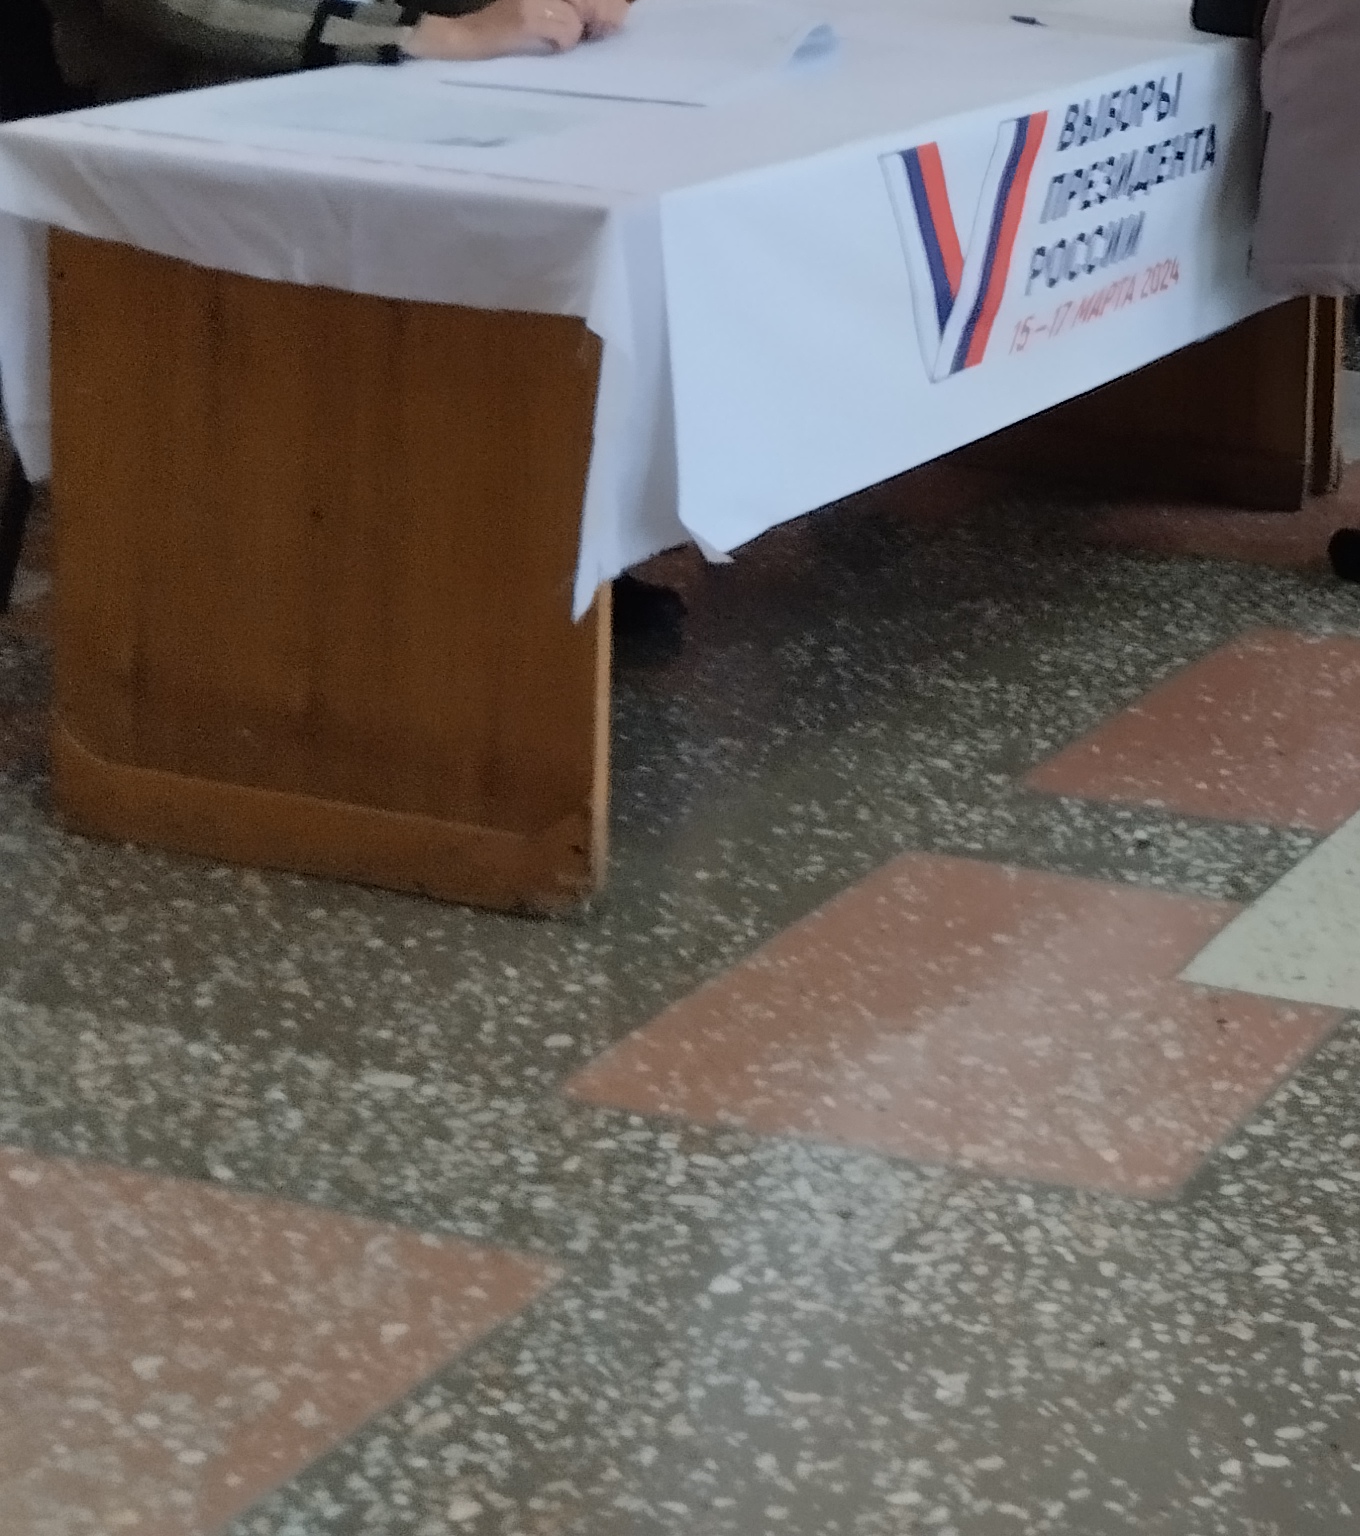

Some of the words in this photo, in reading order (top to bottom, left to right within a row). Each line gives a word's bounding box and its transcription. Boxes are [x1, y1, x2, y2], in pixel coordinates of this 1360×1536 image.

[1056, 71, 1183, 152] ВЫБОРЫ
[1039, 122, 1217, 225] ПРЕЗИДЕНТА
[1024, 210, 1147, 297] РОССИИ
[1072, 275, 1136, 327] МАРТА
[1140, 255, 1181, 299] 2024
